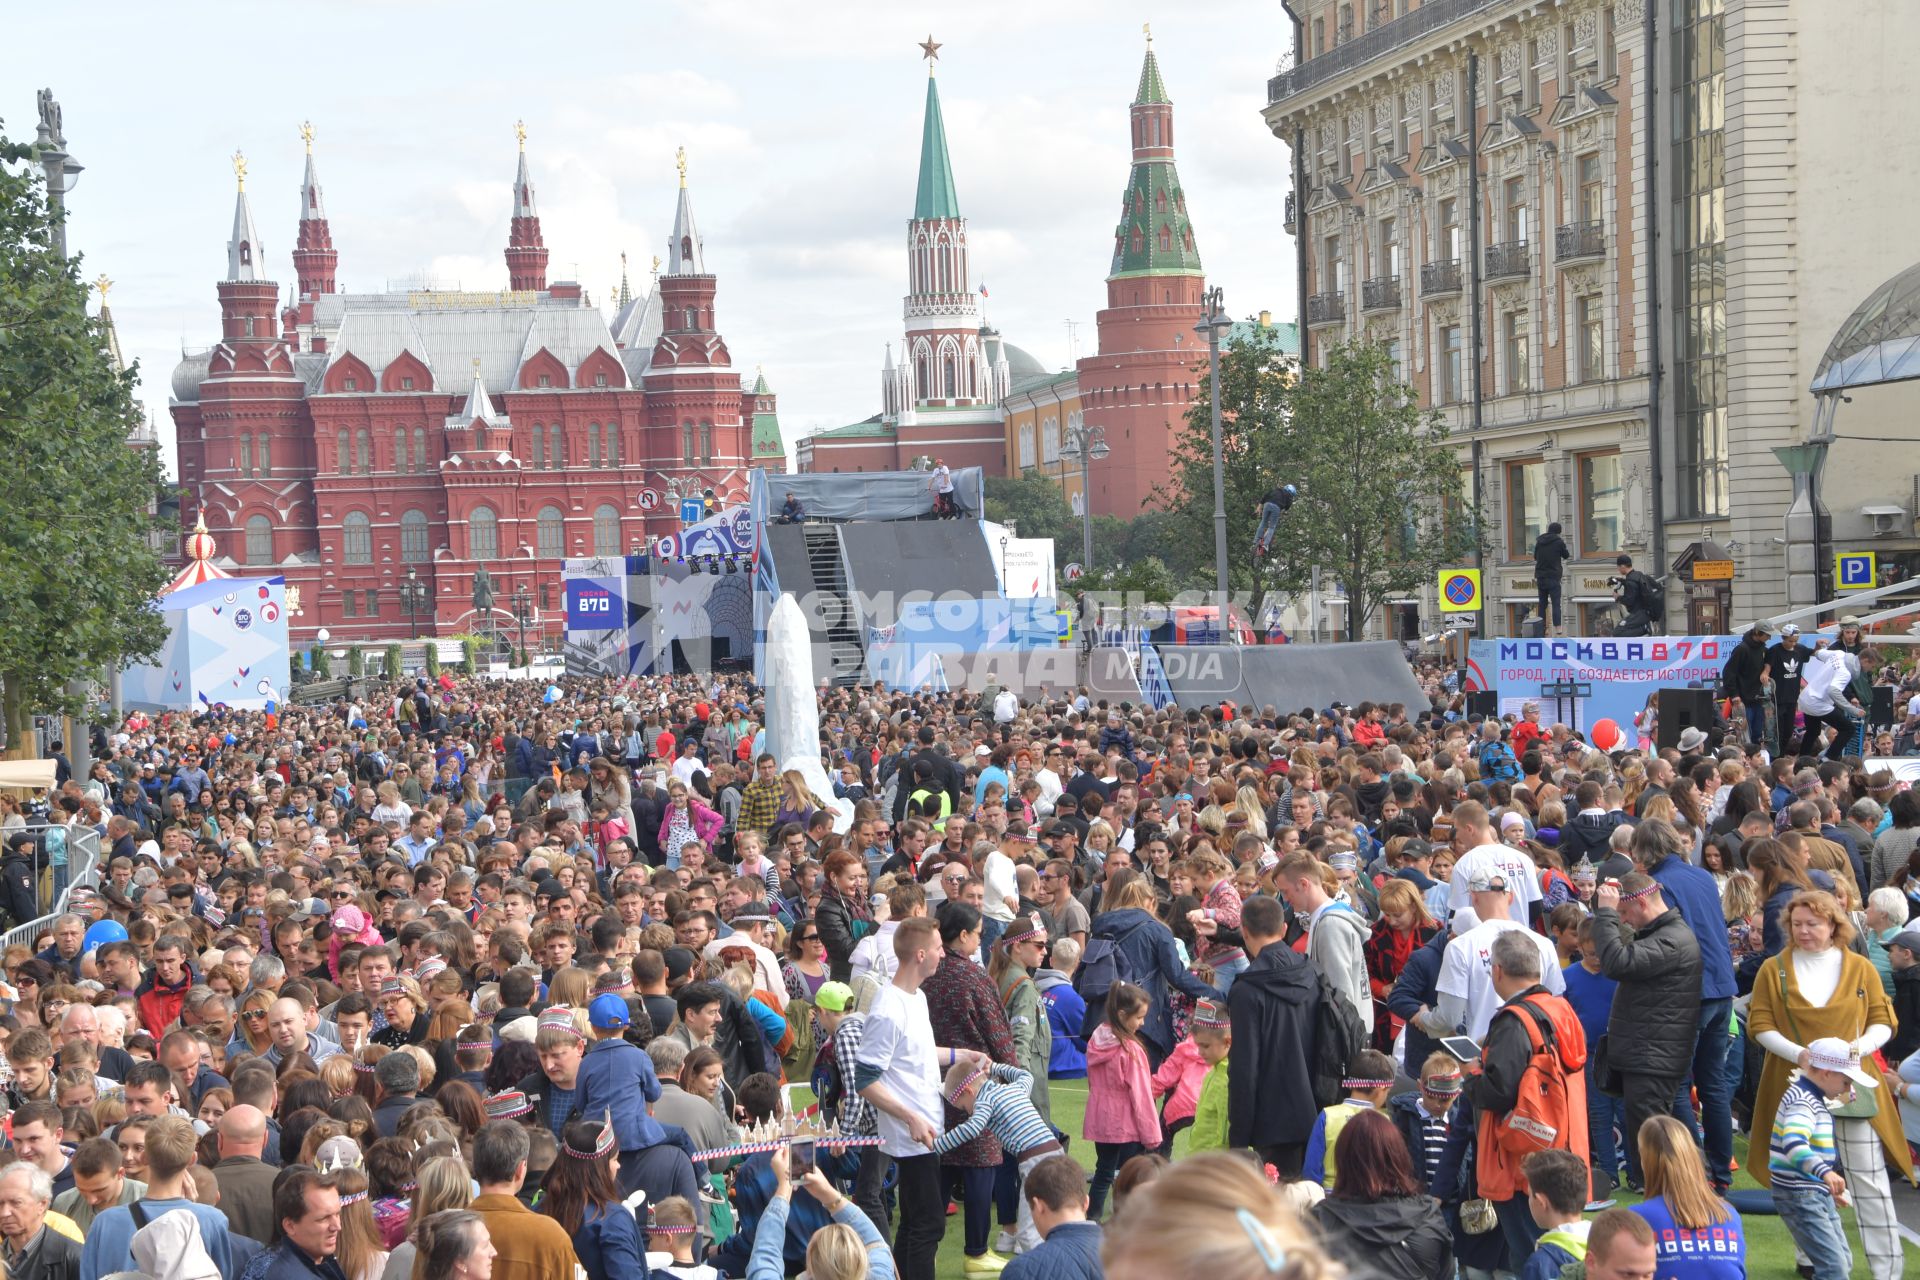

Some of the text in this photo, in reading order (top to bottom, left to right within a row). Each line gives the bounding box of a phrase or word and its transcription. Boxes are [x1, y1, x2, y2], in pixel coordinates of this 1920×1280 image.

[1847, 560, 1864, 581] P
[579, 598, 609, 612] 870
[1501, 668, 1718, 682] ГОРОД, ГДЕ СОЗДАЕТСЯ ИСТОРИЯ
